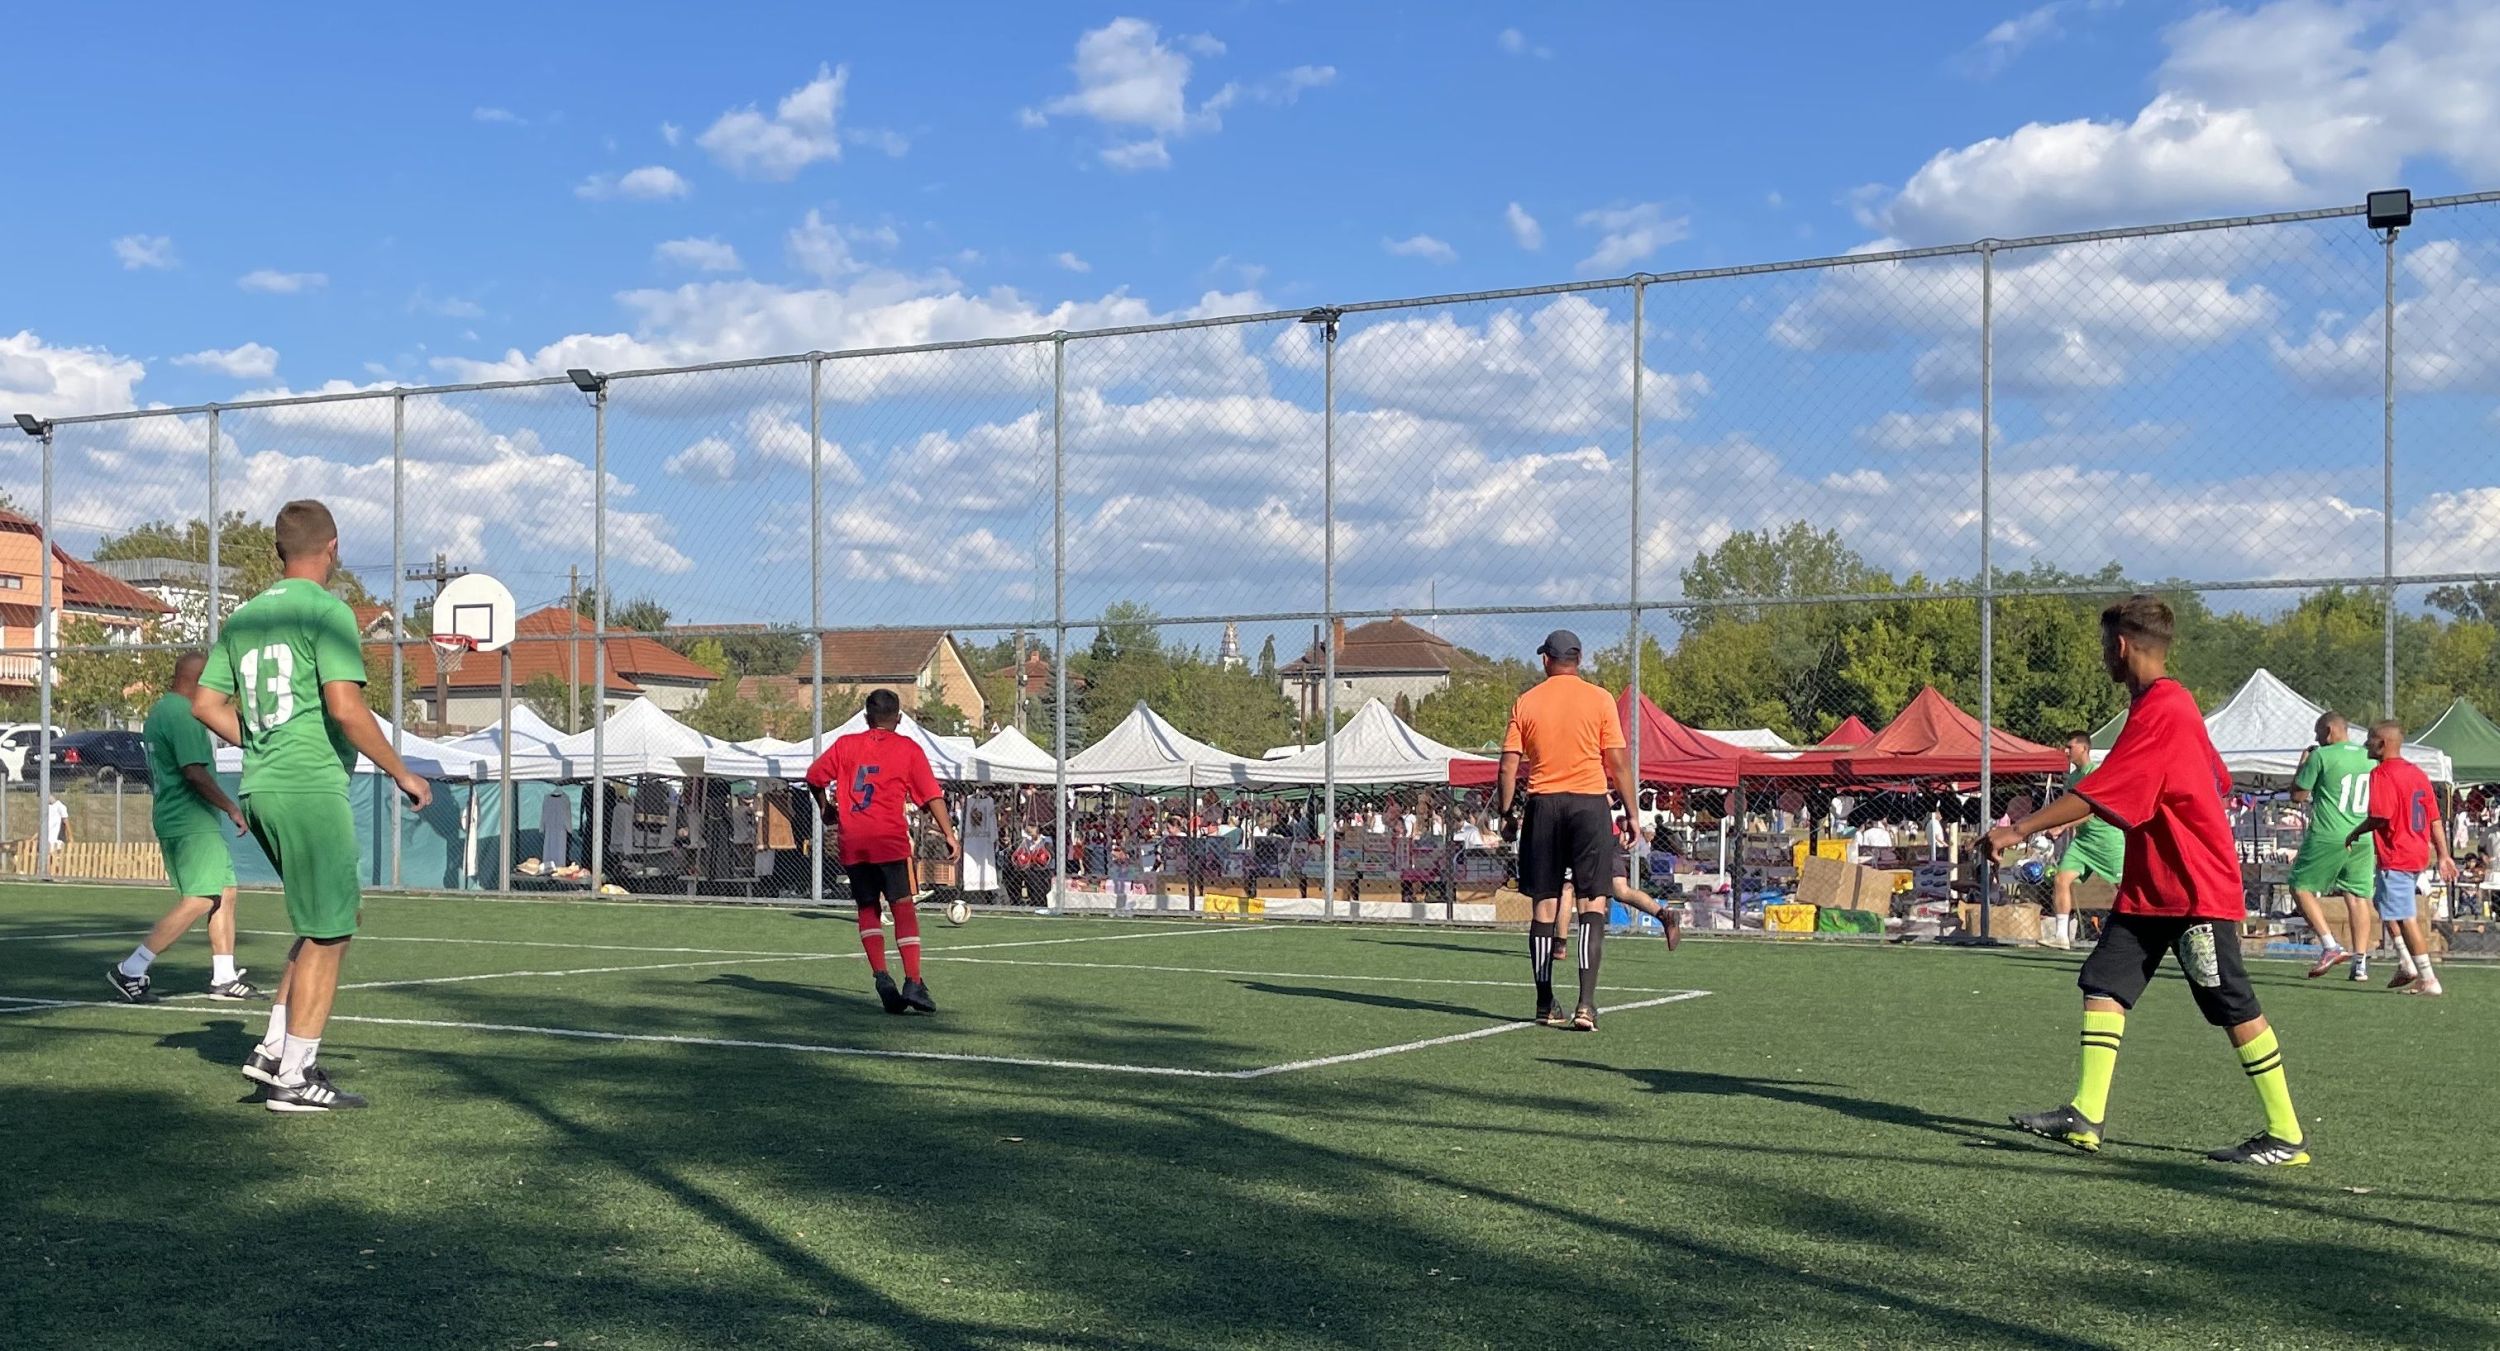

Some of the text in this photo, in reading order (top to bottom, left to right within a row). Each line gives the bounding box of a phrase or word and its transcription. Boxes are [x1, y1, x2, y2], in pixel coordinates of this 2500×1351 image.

[240, 643, 294, 732] 13
[852, 765, 880, 812] 5
[2338, 773, 2370, 813] 10
[2411, 790, 2426, 832] 6
